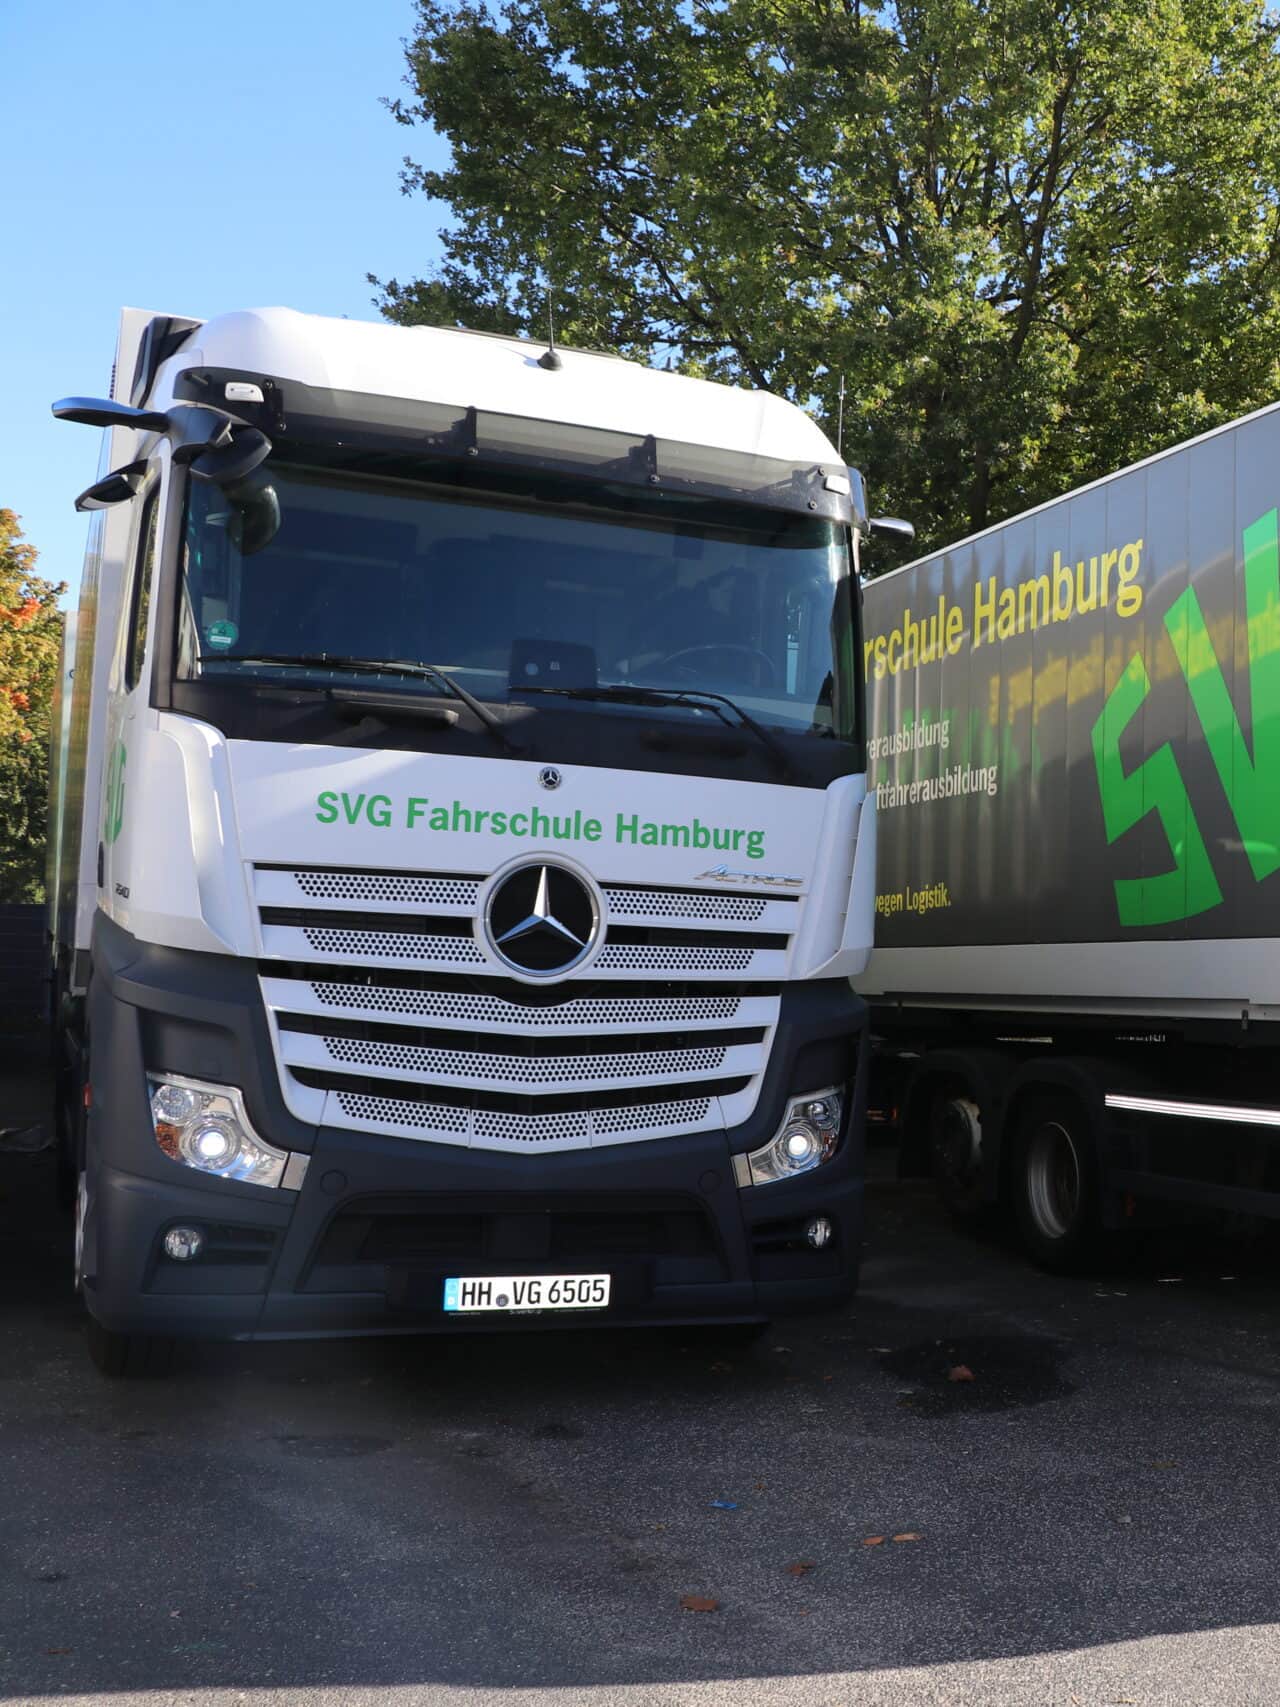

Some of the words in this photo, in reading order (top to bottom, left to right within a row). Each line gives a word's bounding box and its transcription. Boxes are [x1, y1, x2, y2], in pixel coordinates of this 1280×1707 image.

[971, 538, 1143, 649] Hamburg
[867, 719, 950, 760] erausbildung
[314, 790, 392, 828] SVG
[406, 796, 603, 842] Fahrschule
[615, 812, 766, 859] Hamburg
[906, 882, 952, 914] Logistik.
[461, 1281, 493, 1306] HH
[512, 1280, 542, 1305] VG
[548, 1279, 605, 1304] 6505
